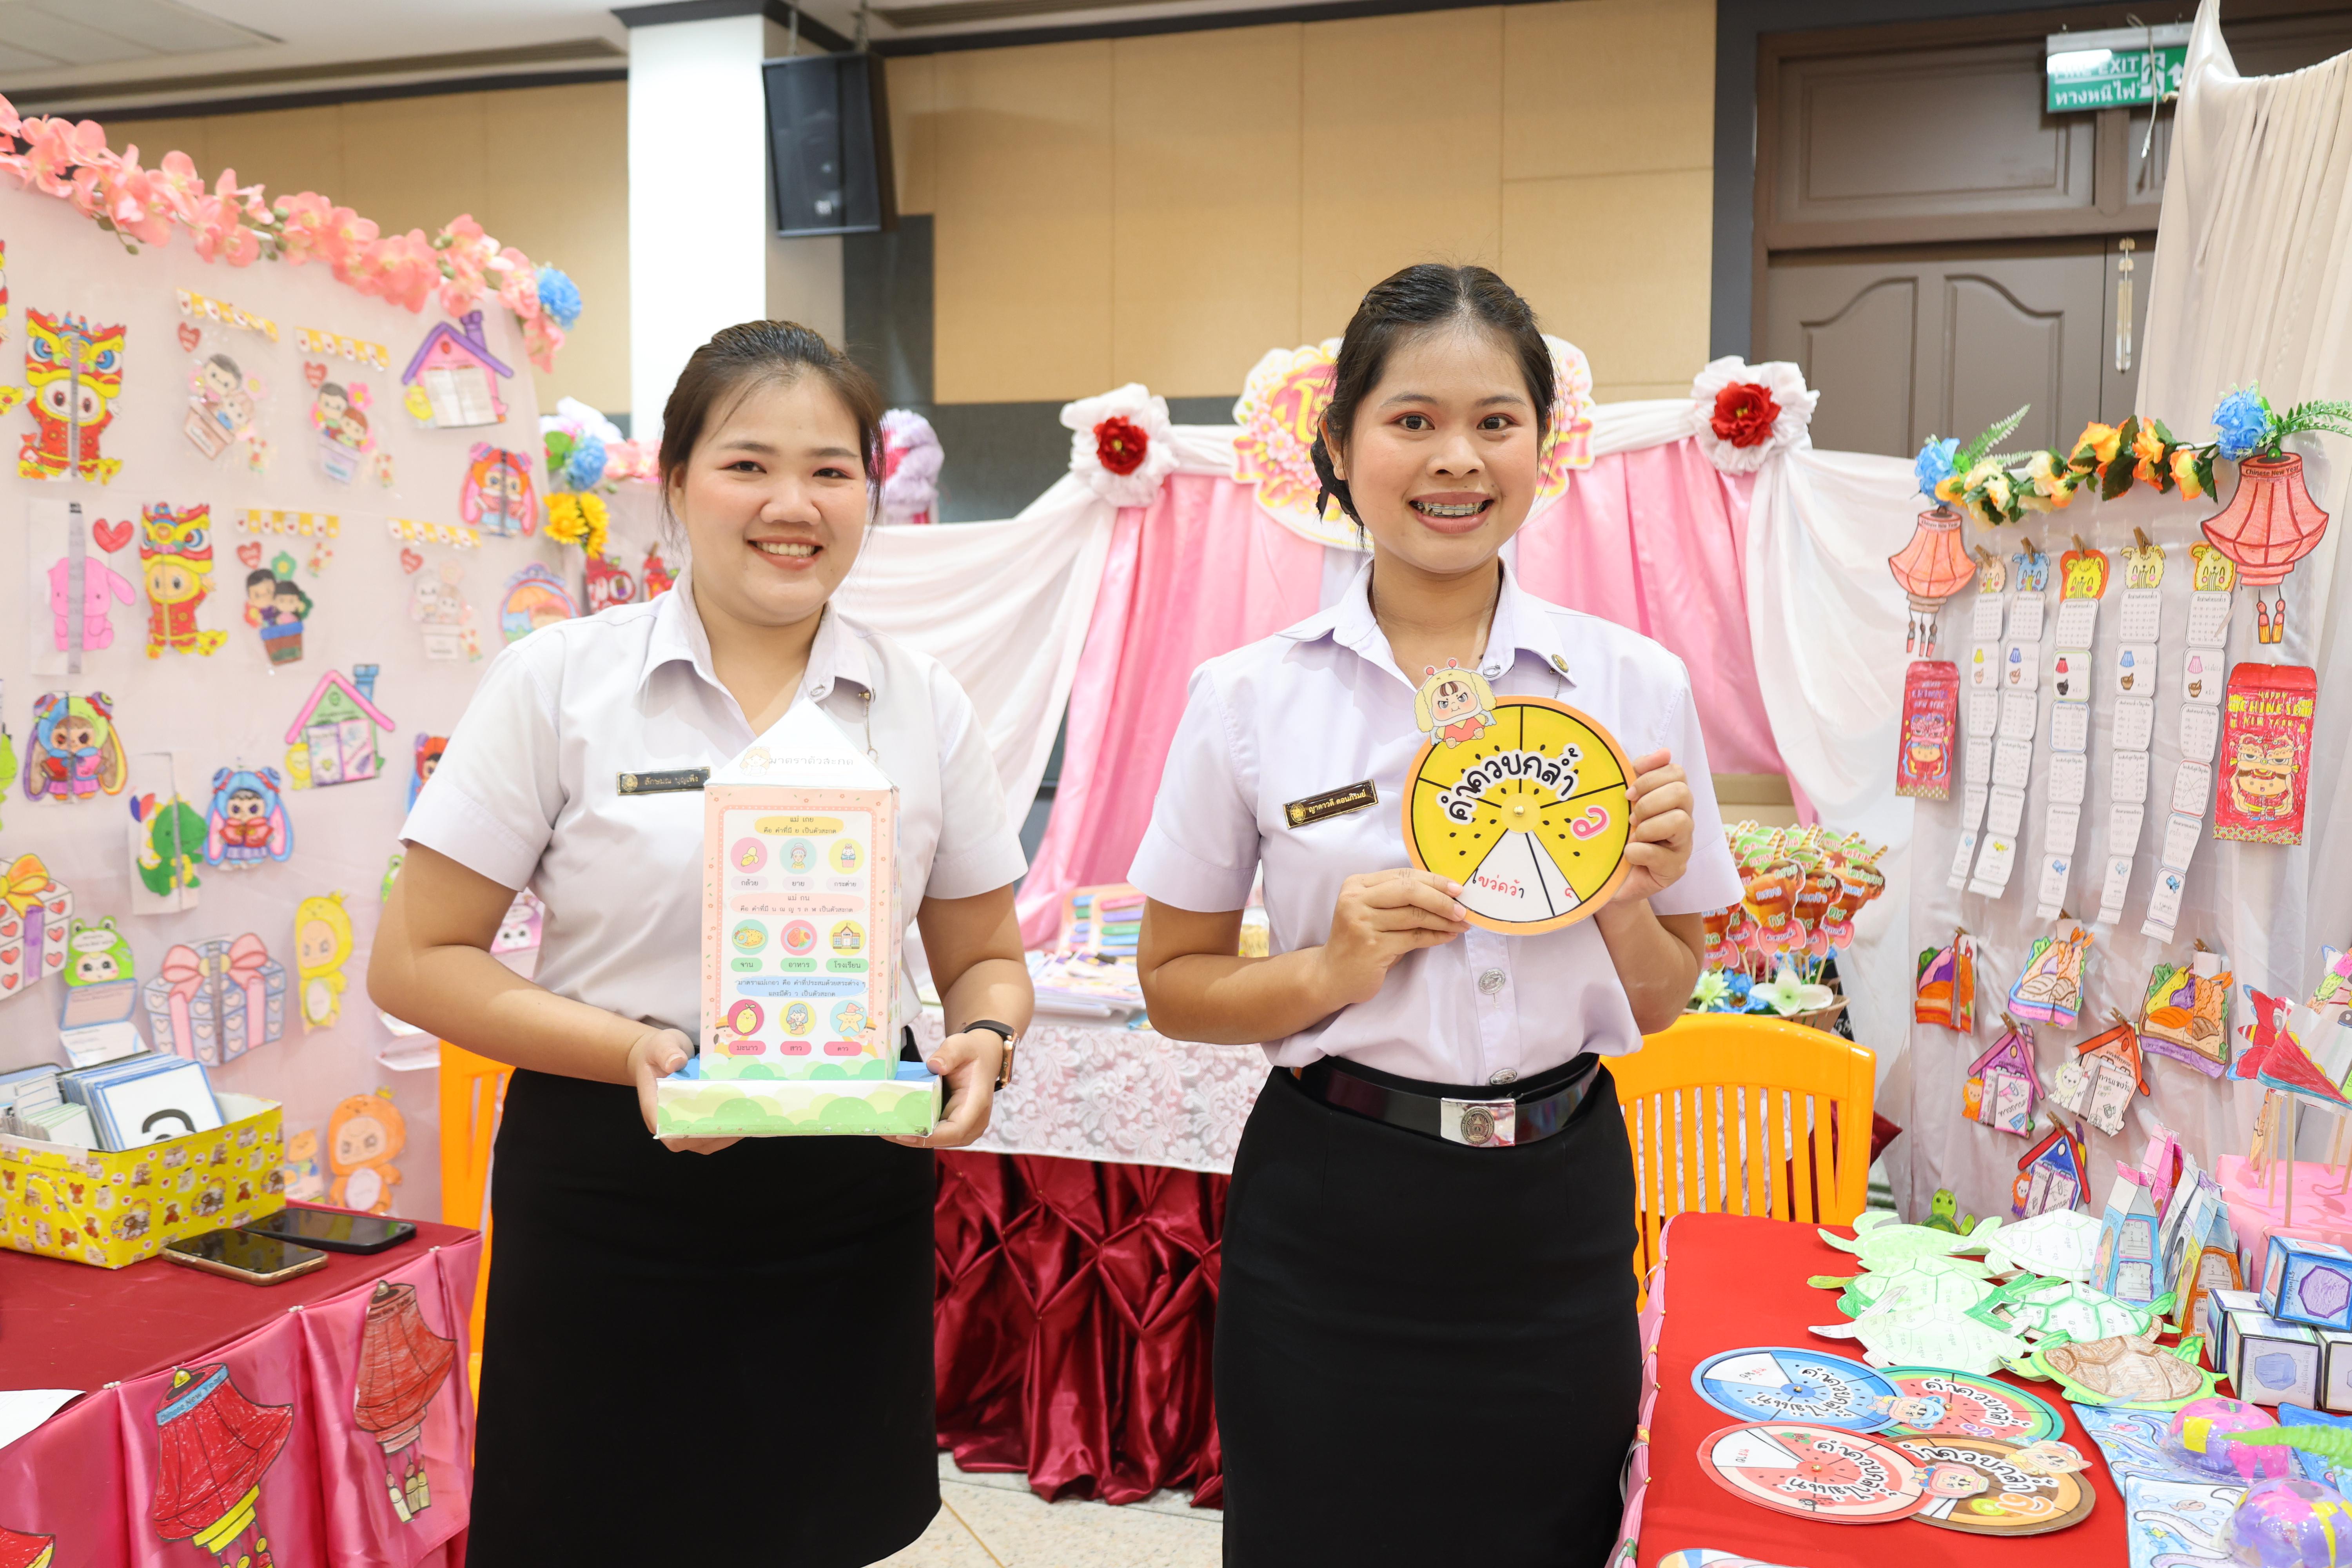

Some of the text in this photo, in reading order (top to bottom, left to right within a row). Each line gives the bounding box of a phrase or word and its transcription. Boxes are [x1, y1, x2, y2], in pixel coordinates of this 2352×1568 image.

[2098, 56, 2140, 74] EXIT
[2286, 465, 2299, 474] Year
[2258, 691, 2288, 700] HAPPY
[2239, 700, 2301, 716] CHINESE
[2243, 716, 2265, 726] NEW
[769, 755, 854, 766] มาตราตัวสะกด
[1441, 748, 1579, 820] คำควบกล้ำ
[775, 824, 792, 834] คำที่มี
[802, 826, 837, 835] เป็นตัวสะกด
[741, 878, 759, 887] กล้วย
[834, 879, 857, 887] กระต่าย
[752, 903, 769, 912] คำที่มี
[819, 904, 853, 913] เป็นตัวสะกด
[834, 960, 861, 969] โรงเรียน
[794, 978, 859, 987] คำที่ประสมด้วยสระต่าง
[802, 989, 836, 998] เป็นตัวสะกด
[186, 1391, 202, 1406] New
[203, 1375, 222, 1396] Year
[1926, 1378, 2031, 1426] คำควบกล้ำ
